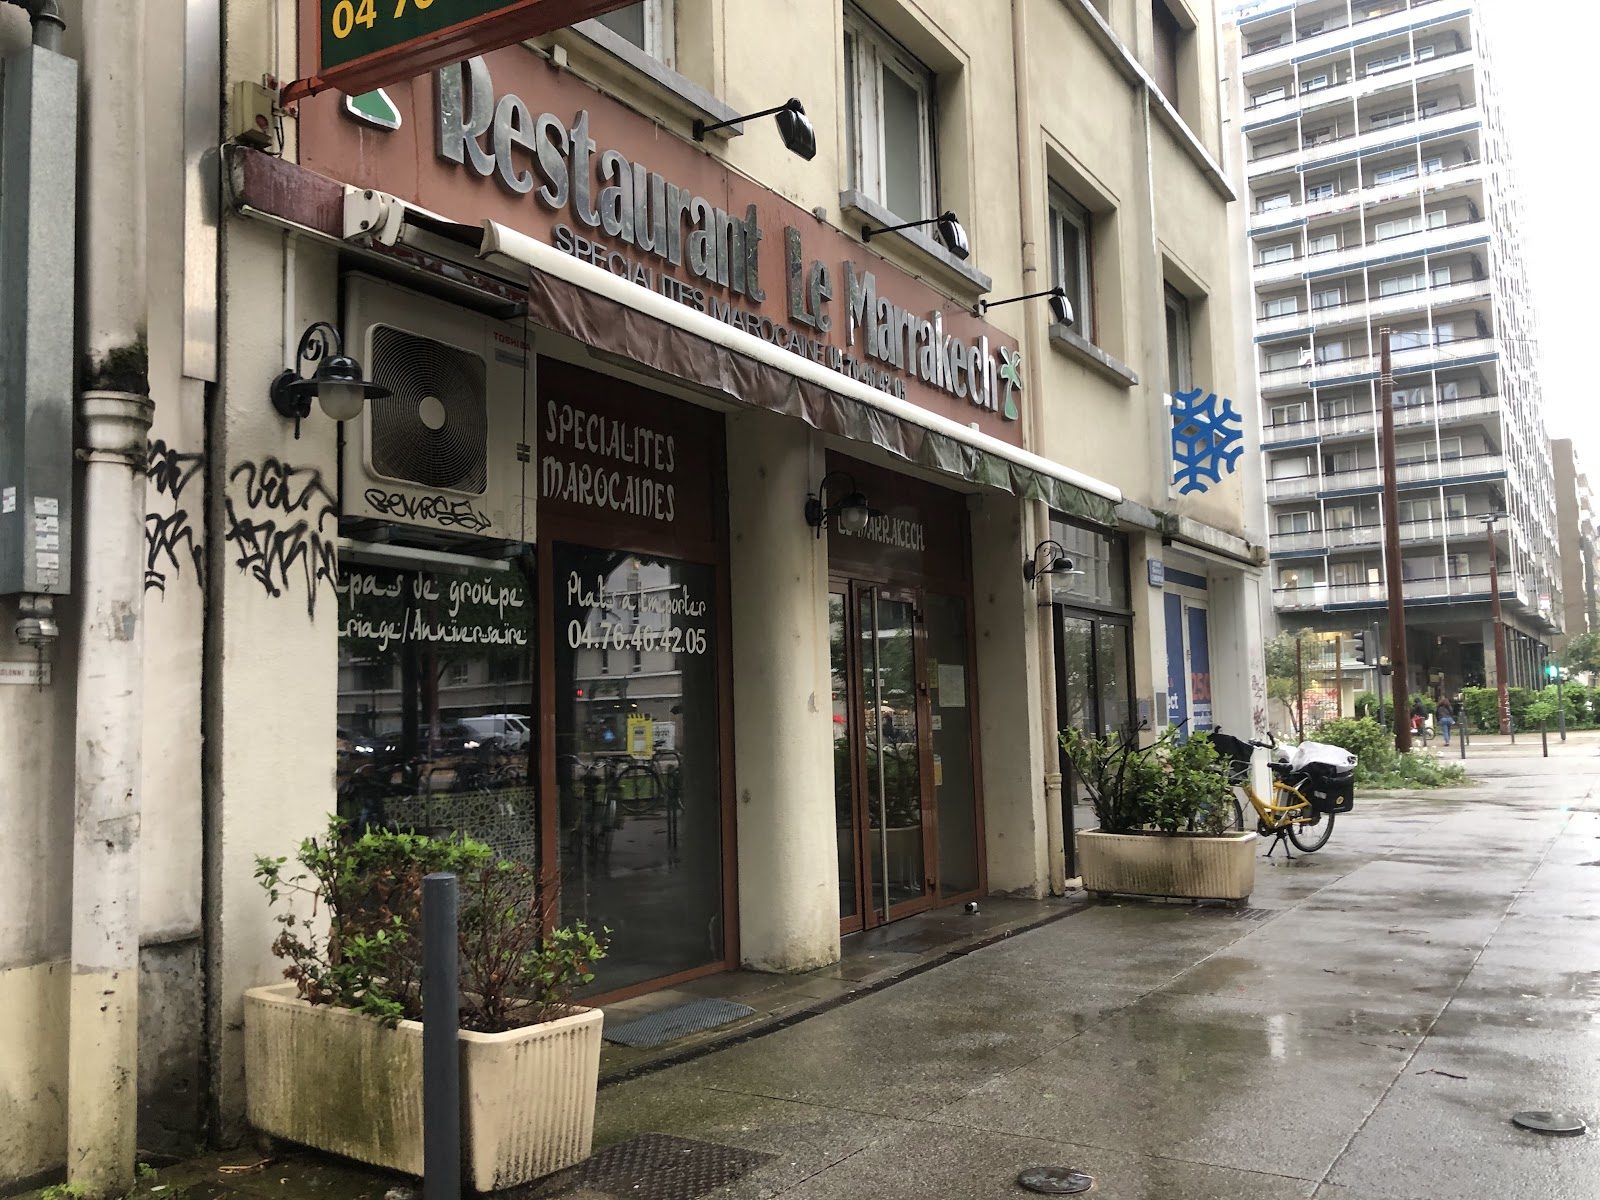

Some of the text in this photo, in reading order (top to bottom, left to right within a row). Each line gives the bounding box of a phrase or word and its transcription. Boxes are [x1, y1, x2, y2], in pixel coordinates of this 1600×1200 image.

[332, 0, 377, 39] 04
[438, 54, 998, 412] Restaurant Le Marrakech
[545, 399, 676, 474] SPECIALITES
[542, 455, 676, 522] MAROCAINES
[413, 571, 440, 601] de
[448, 576, 525, 620] groupe
[567, 570, 617, 610] Plats
[567, 618, 707, 655] 04.76.46.42.05
